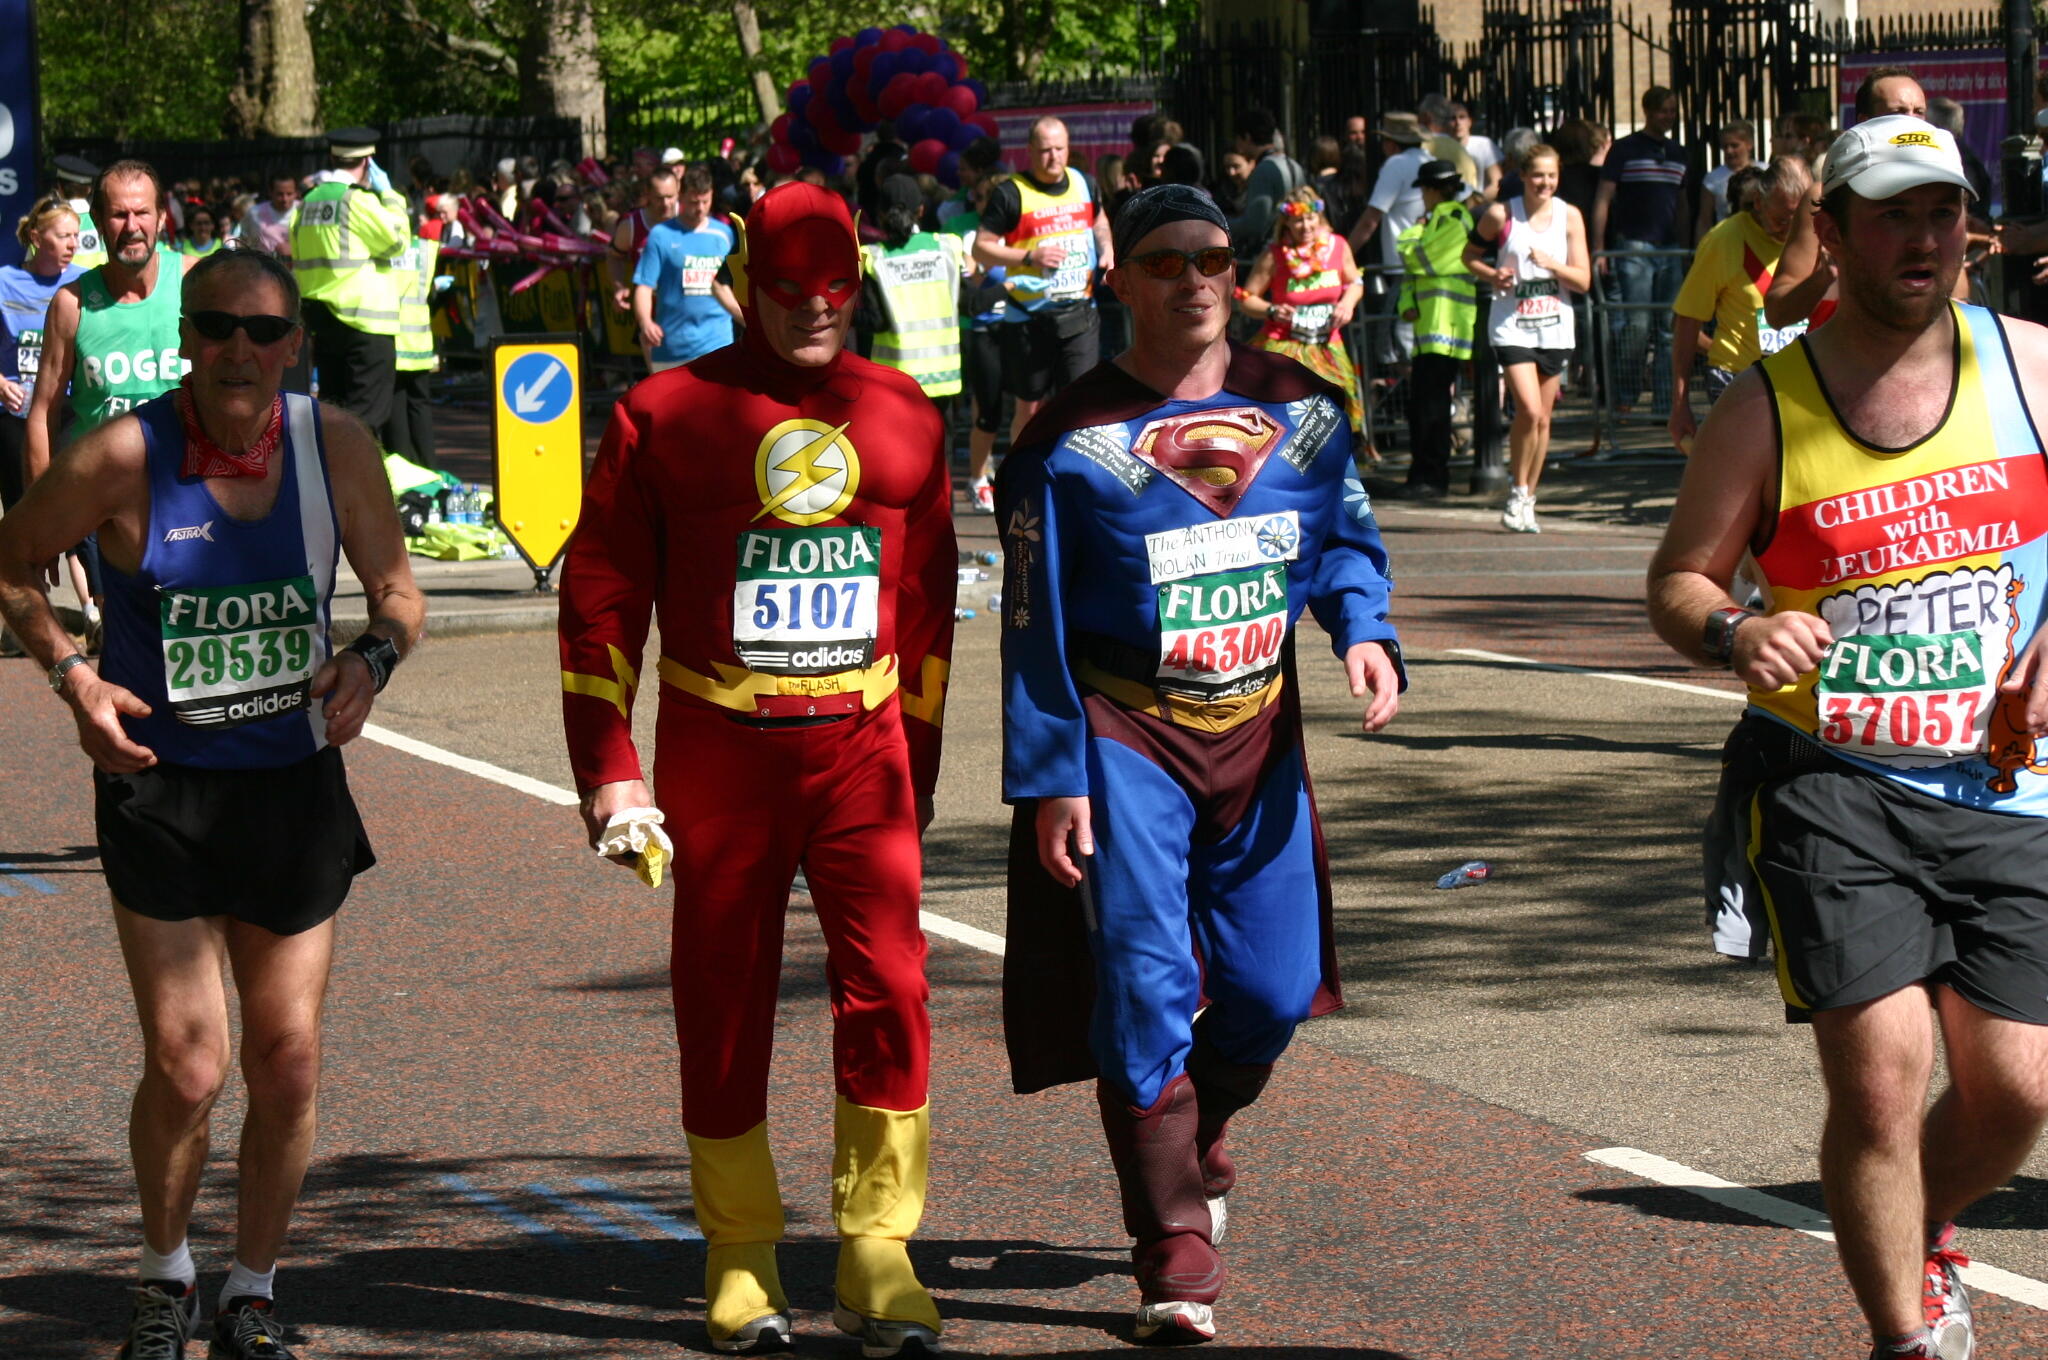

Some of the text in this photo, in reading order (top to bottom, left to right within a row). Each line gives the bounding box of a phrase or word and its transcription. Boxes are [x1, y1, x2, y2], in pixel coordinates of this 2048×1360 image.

[1896, 133, 1930, 144] SBR
[1033, 203, 1086, 219] CHILDREN
[685, 255, 722, 268] FLORA
[901, 270, 932, 281] CADET
[911, 260, 936, 270] JOHN
[1517, 280, 1558, 297] FLORA
[1072, 434, 1126, 472] NOLAN Trust
[1093, 433, 1134, 466] ANTHONY
[1281, 411, 1319, 460] The ANTHONY
[1292, 421, 1326, 465] NOLAN Trust
[1814, 461, 2010, 529] CHILDREN
[163, 519, 215, 542] FASTRAX
[1148, 520, 1258, 554] The ANTHONY
[1881, 504, 1952, 542] with
[741, 530, 875, 574] FLORA
[1152, 550, 1251, 579] NOLAN Trust
[1820, 519, 2021, 583] LEUKAEMIA
[1022, 559, 1030, 604] ANTHONY
[1165, 569, 1285, 622] FLORA
[166, 584, 310, 630] FLORA
[752, 582, 860, 630] 5107
[1856, 579, 2000, 636] PETER
[167, 628, 311, 690] 29539
[792, 645, 864, 669] adidas
[1162, 616, 1284, 673] 46300
[1825, 637, 1982, 687] FLORA
[801, 677, 840, 692] FLASH
[1209, 674, 1267, 700] adidas
[228, 689, 303, 721] adidas
[1823, 690, 1982, 748] 37057
